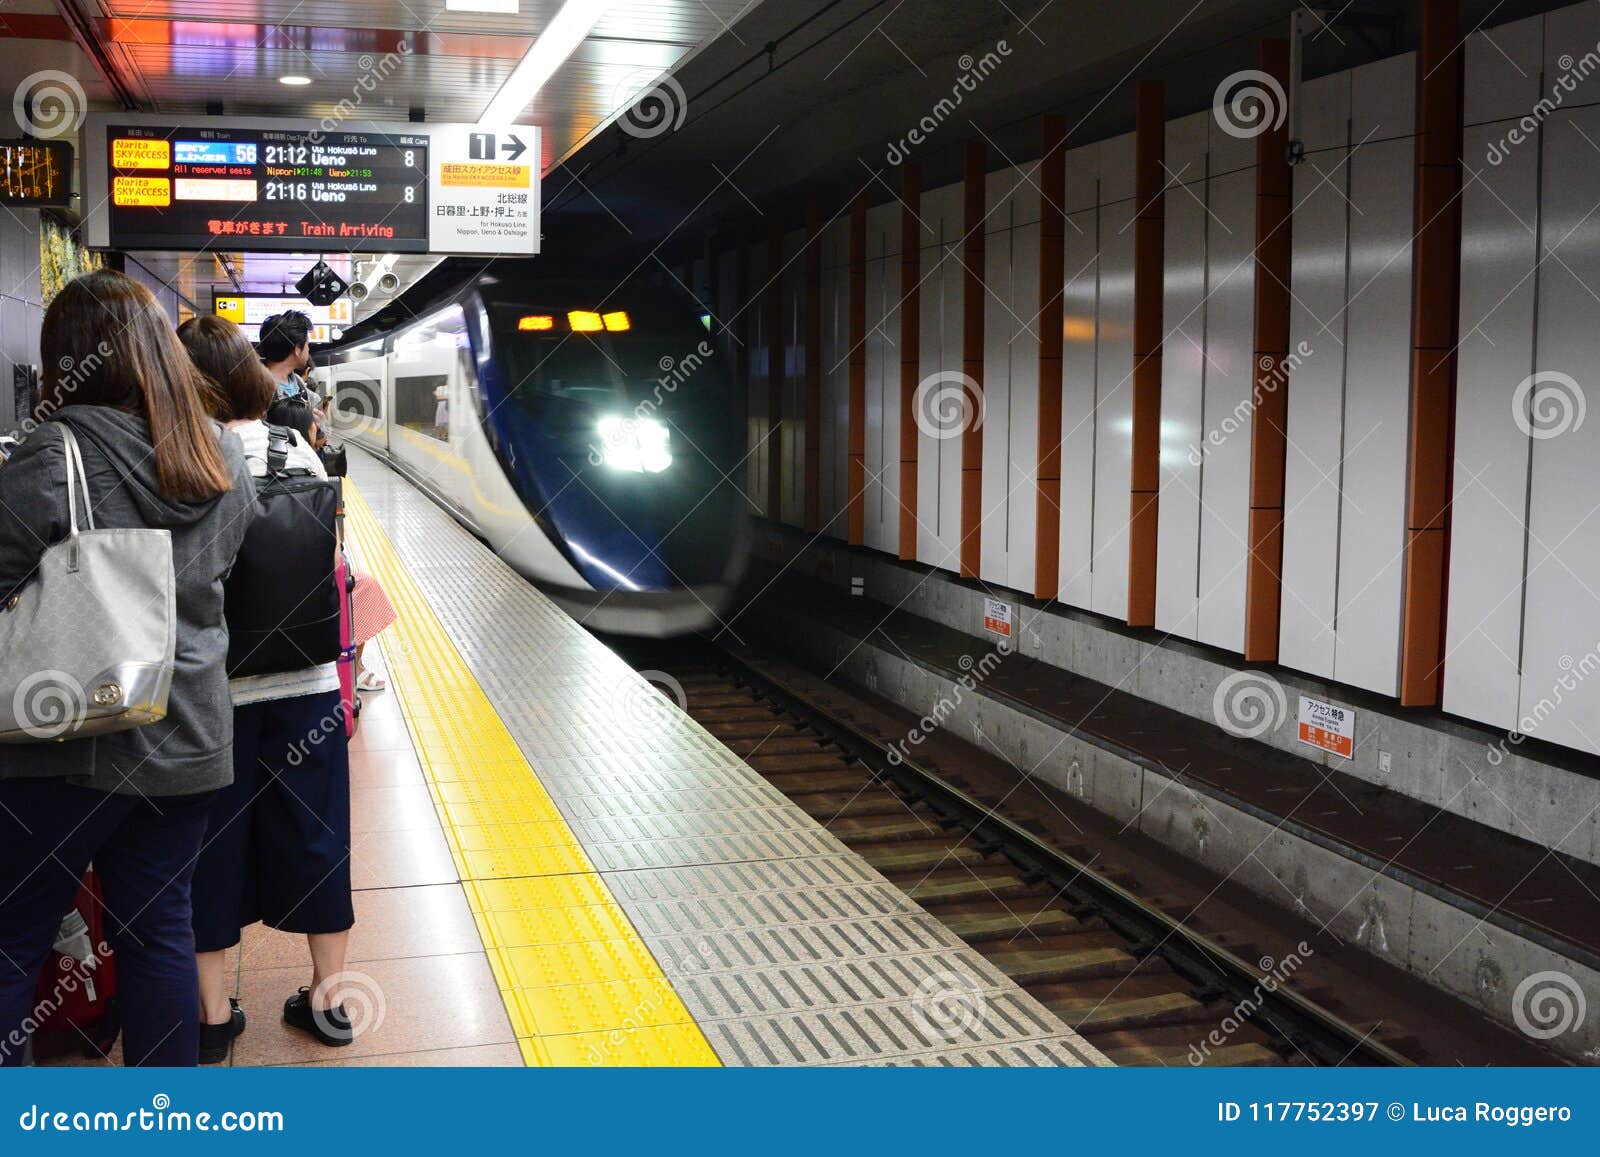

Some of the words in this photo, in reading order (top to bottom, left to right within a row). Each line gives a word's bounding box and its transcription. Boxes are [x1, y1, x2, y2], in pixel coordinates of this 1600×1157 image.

[116, 140, 148, 149] Narita
[116, 151, 133, 159] SKY
[136, 151, 168, 160] ACCESS
[236, 145, 257, 163] 56
[265, 146, 307, 165] 21:12
[311, 146, 324, 154] Via
[359, 147, 377, 156] Line
[117, 160, 138, 168] Line
[311, 154, 346, 166] Ueno
[404, 150, 414, 167] 8
[174, 166, 188, 174] All
[192, 166, 226, 175] reserved
[267, 167, 297, 177] Nippori
[328, 168, 347, 177] Ueno
[443, 164, 522, 176] 成田スカイアクセス線
[116, 178, 149, 187] Narita
[311, 182, 324, 191] Via
[359, 183, 377, 192] Line
[117, 188, 134, 196] SKY
[136, 188, 168, 197] ACCESS
[266, 182, 307, 201] 21:16
[311, 190, 346, 202] Ueno
[404, 186, 414, 203] 8
[497, 192, 527, 204] 北総線
[207, 220, 288, 236] 電車がきます
[301, 222, 335, 236] Train
[340, 223, 394, 238] Arriving
[481, 228, 496, 236] Ueno
[1308, 701, 1345, 722] アクセス特急
